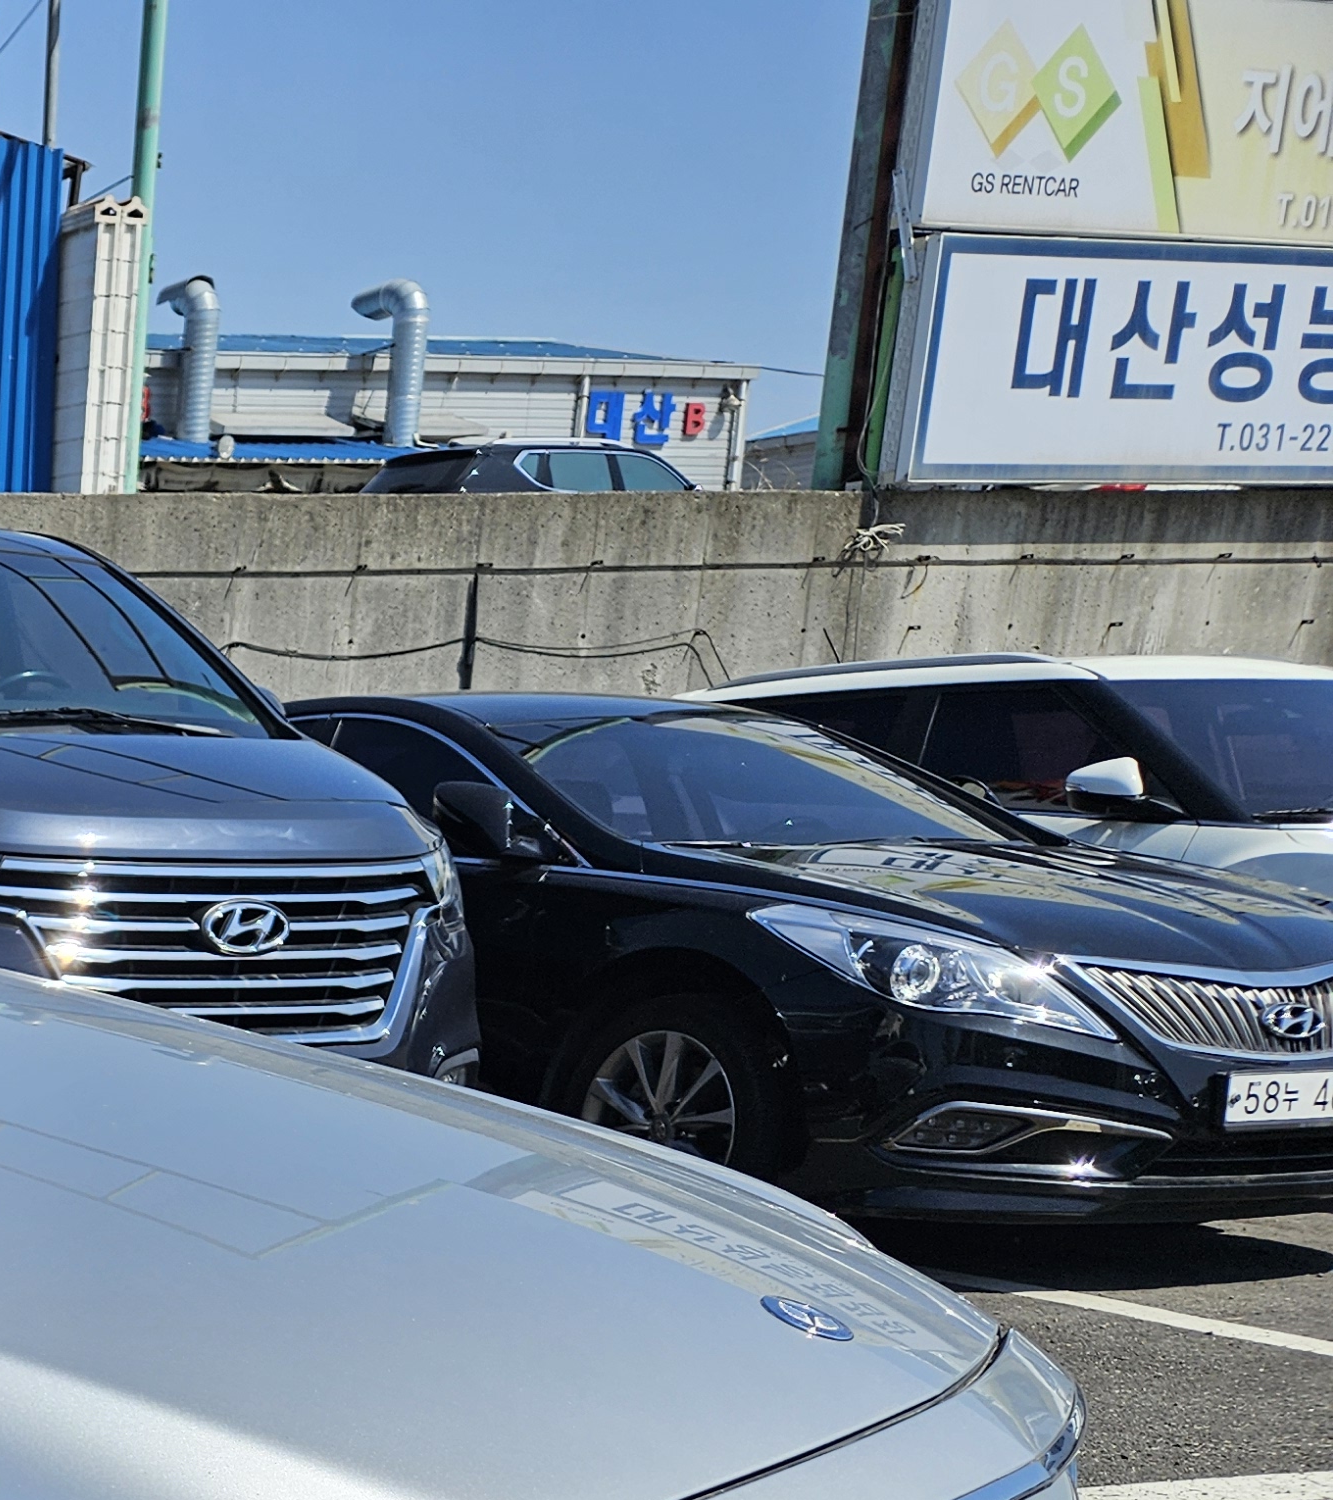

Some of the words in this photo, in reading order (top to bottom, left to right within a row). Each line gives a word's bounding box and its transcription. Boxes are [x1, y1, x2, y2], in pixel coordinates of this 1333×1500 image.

[980, 52, 1089, 119] GS
[971, 172, 996, 194] GS
[1000, 175, 1080, 198] RENTCAR
[587, 388, 677, 444] 대산
[1217, 422, 1332, 452] T.031-22
[1244, 1081, 1299, 1115] 58누
[1312, 1079, 1333, 1112] 4
